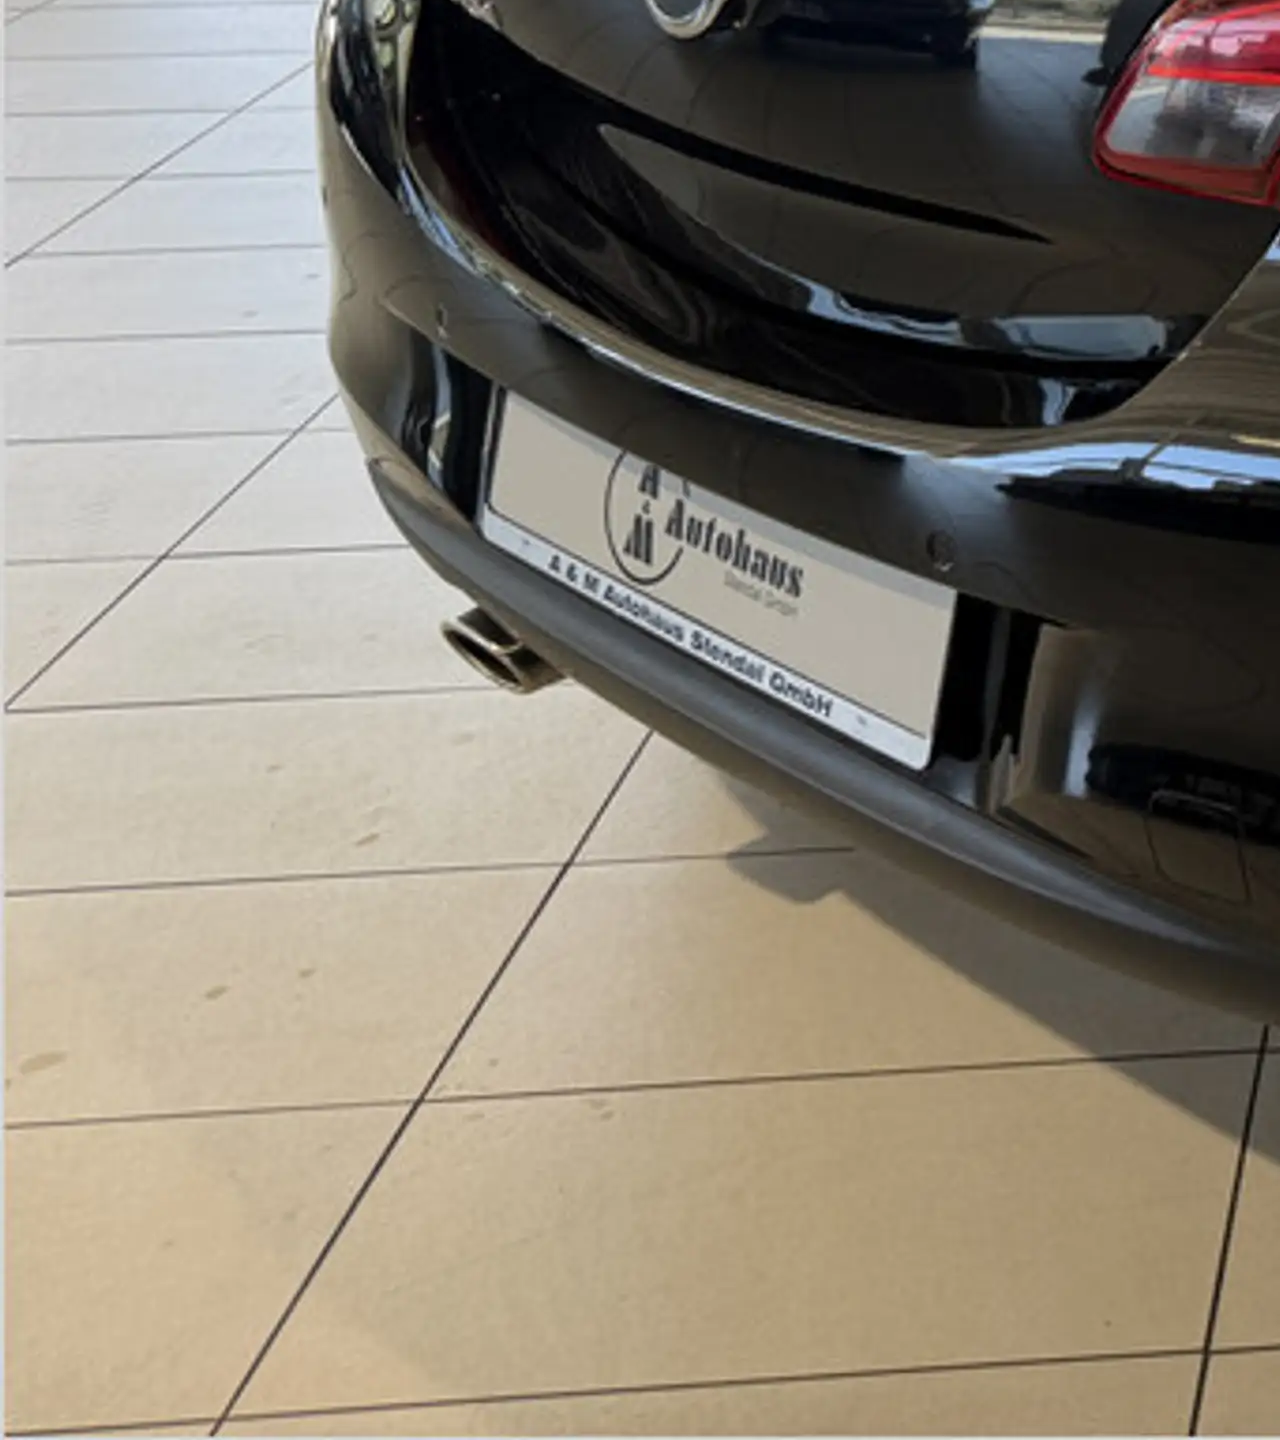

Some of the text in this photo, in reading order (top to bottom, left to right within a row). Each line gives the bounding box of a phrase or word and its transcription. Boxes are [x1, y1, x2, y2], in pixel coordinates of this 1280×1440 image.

[638, 464, 660, 500] A
[623, 514, 654, 565] M
[664, 498, 804, 598] Autohaus
[603, 584, 685, 643] Autohaus
[690, 629, 767, 683] Stendal
[769, 670, 834, 718] GmbH
